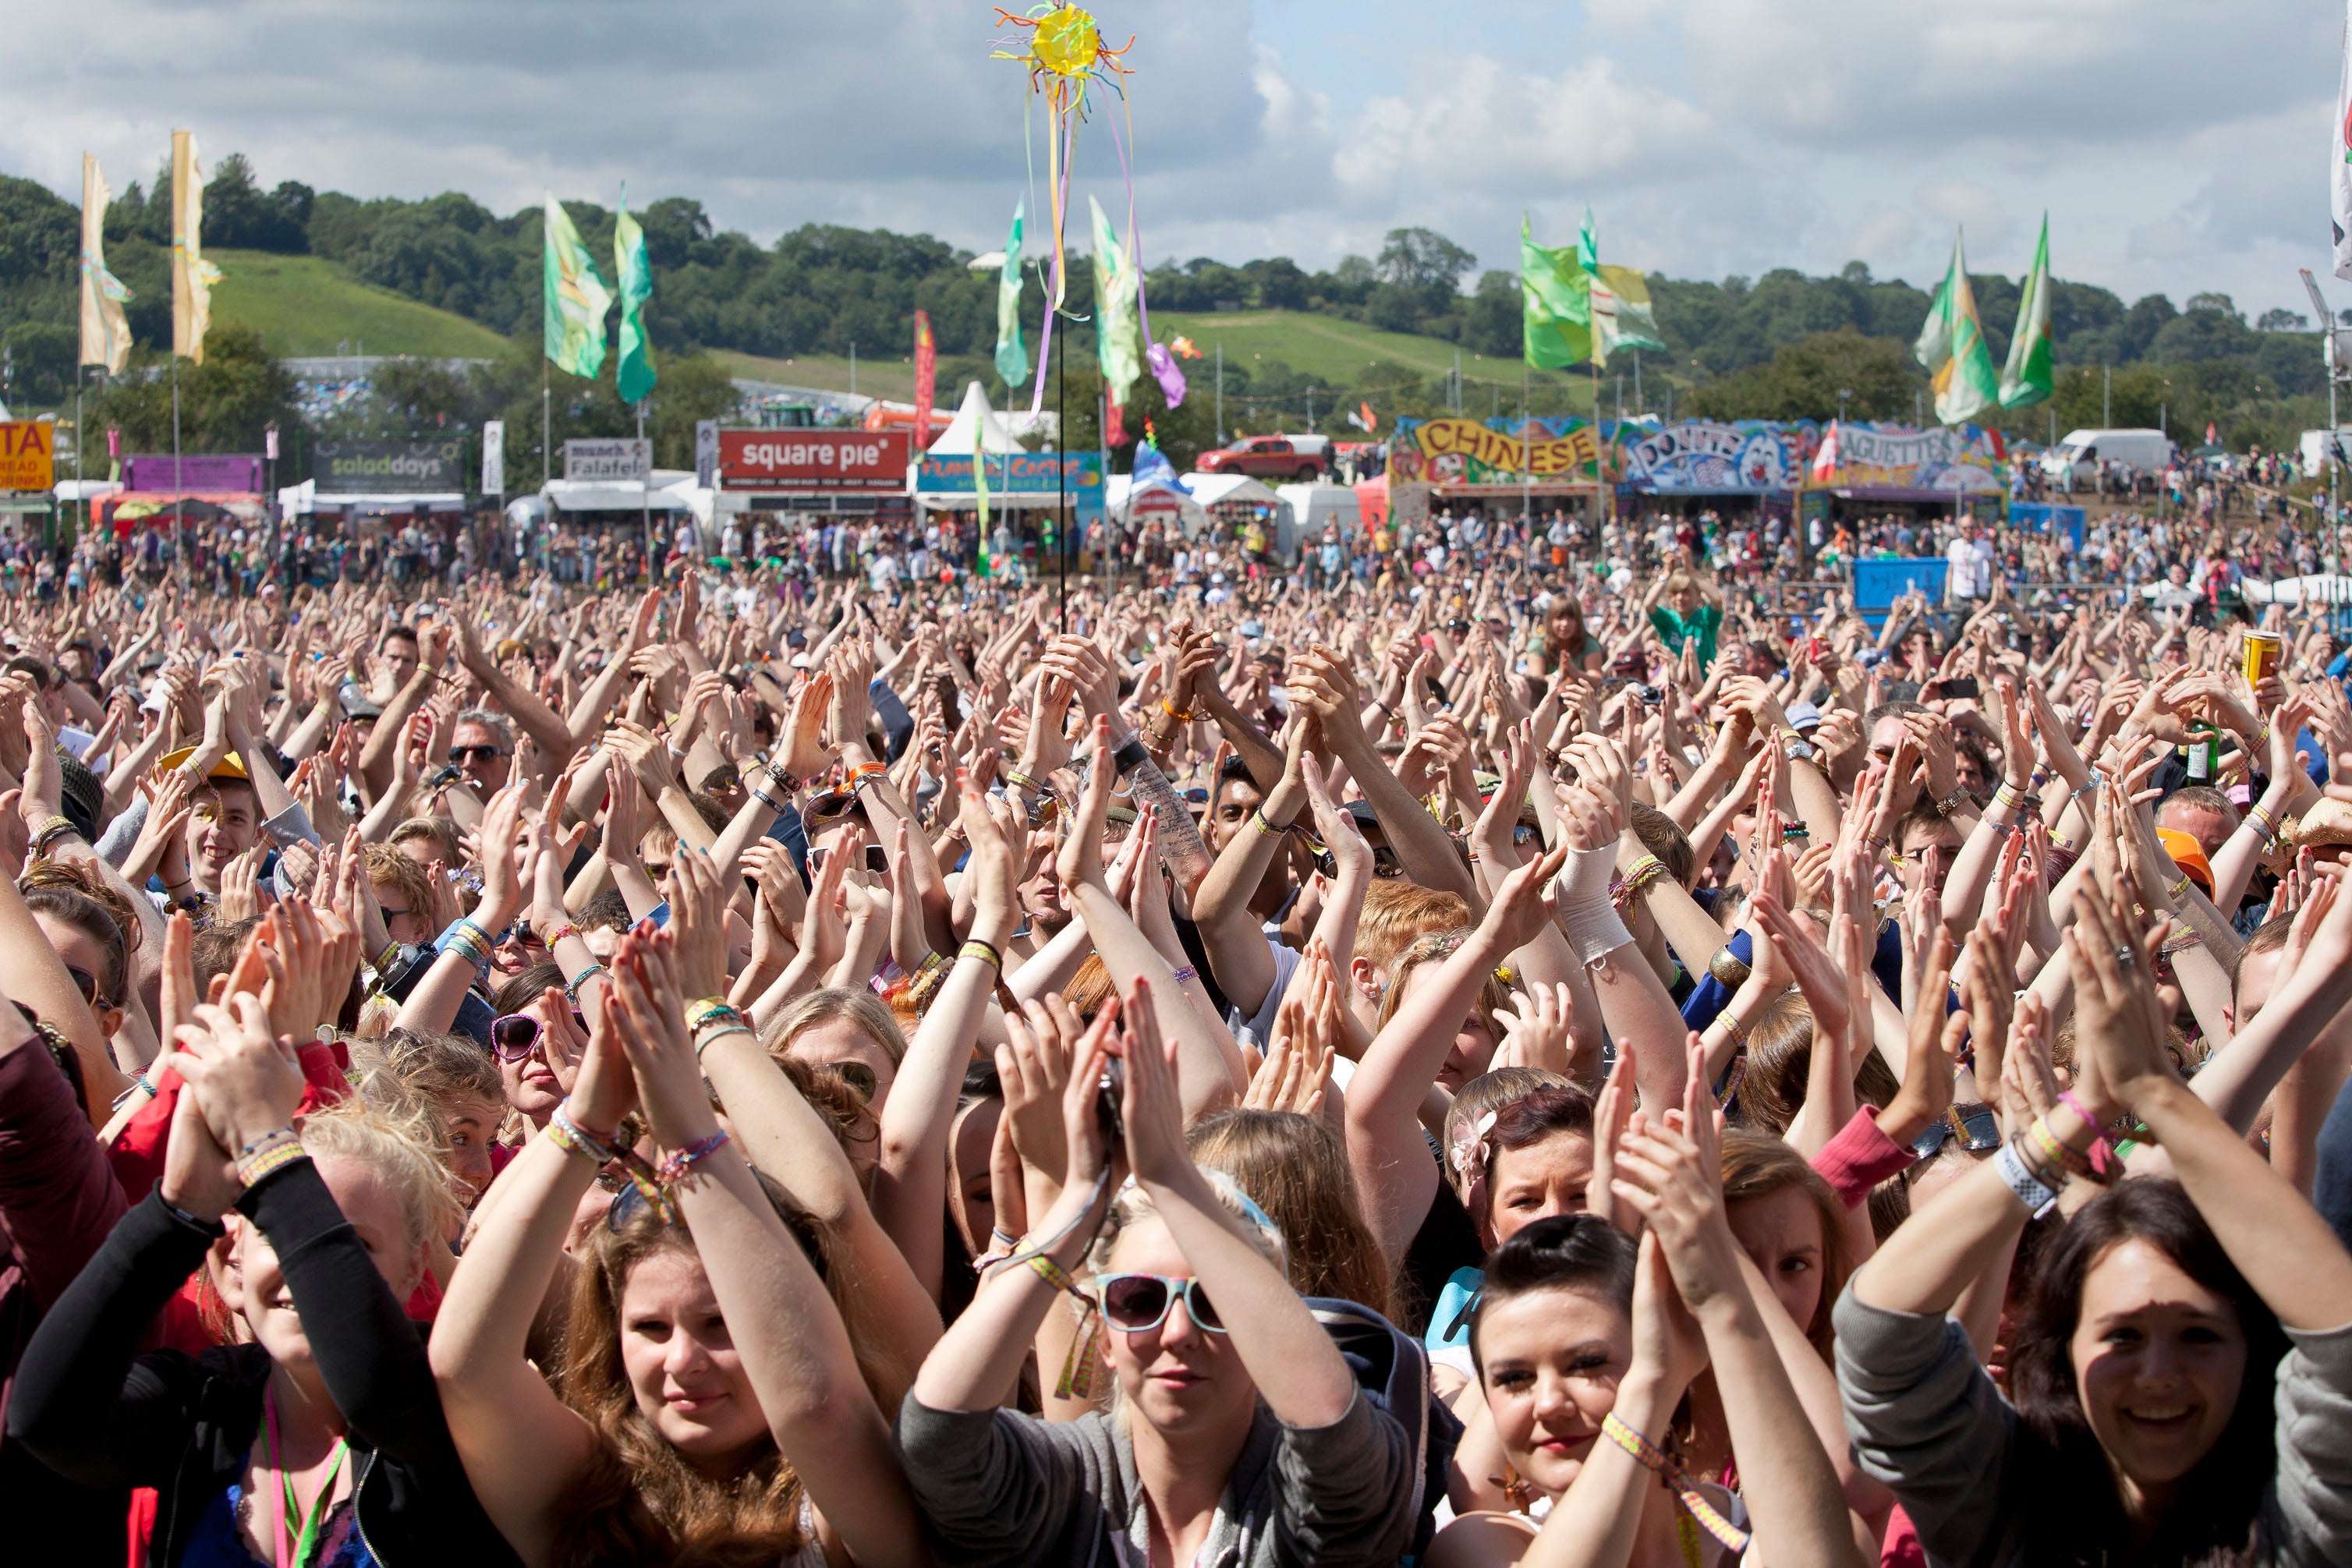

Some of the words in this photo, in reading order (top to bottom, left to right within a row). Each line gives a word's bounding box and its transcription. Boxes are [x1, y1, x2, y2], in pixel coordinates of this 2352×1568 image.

[742, 444, 834, 472] square
[840, 444, 880, 472] pie
[1427, 422, 1595, 471] CHINESE
[1641, 428, 1741, 466] DONUTS
[1837, 429, 1953, 464] AGUETTES
[331, 454, 441, 480] saladdays
